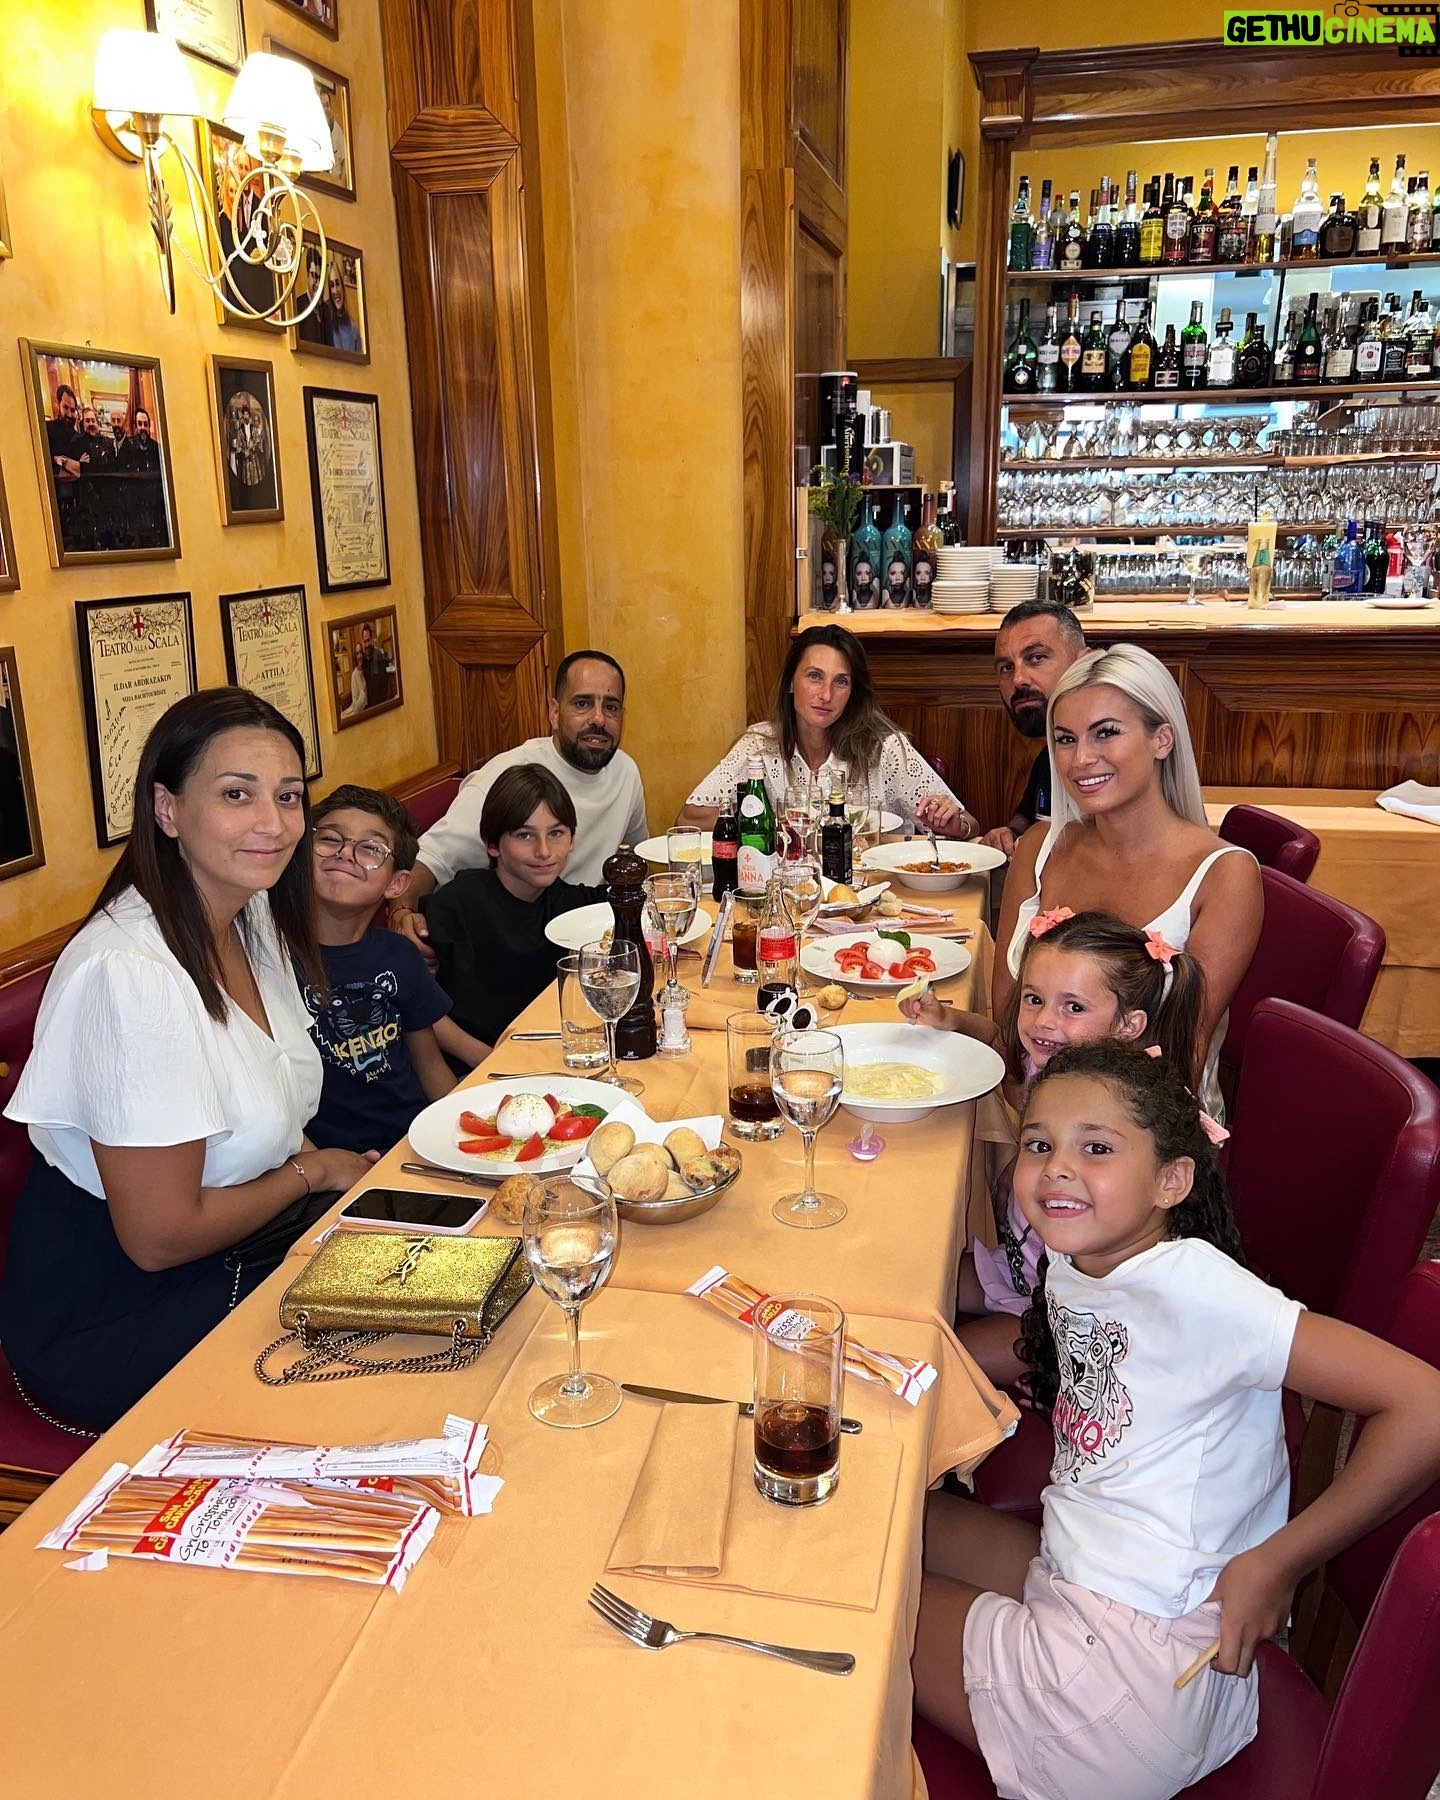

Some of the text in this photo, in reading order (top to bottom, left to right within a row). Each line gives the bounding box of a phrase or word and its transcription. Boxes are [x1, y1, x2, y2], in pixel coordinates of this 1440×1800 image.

[236, 626, 264, 642] TEATRO
[274, 621, 298, 635] SCALA
[97, 640, 133, 658] TEATRO
[148, 633, 180, 650] SCALA
[261, 666, 285, 680] ATTILA
[113, 681, 133, 691] ILDAR
[334, 1023, 398, 1060] KENZO
[193, 1479, 215, 1500] CARL
[160, 1504, 182, 1522] SAN
[165, 1500, 195, 1529] CARLO
